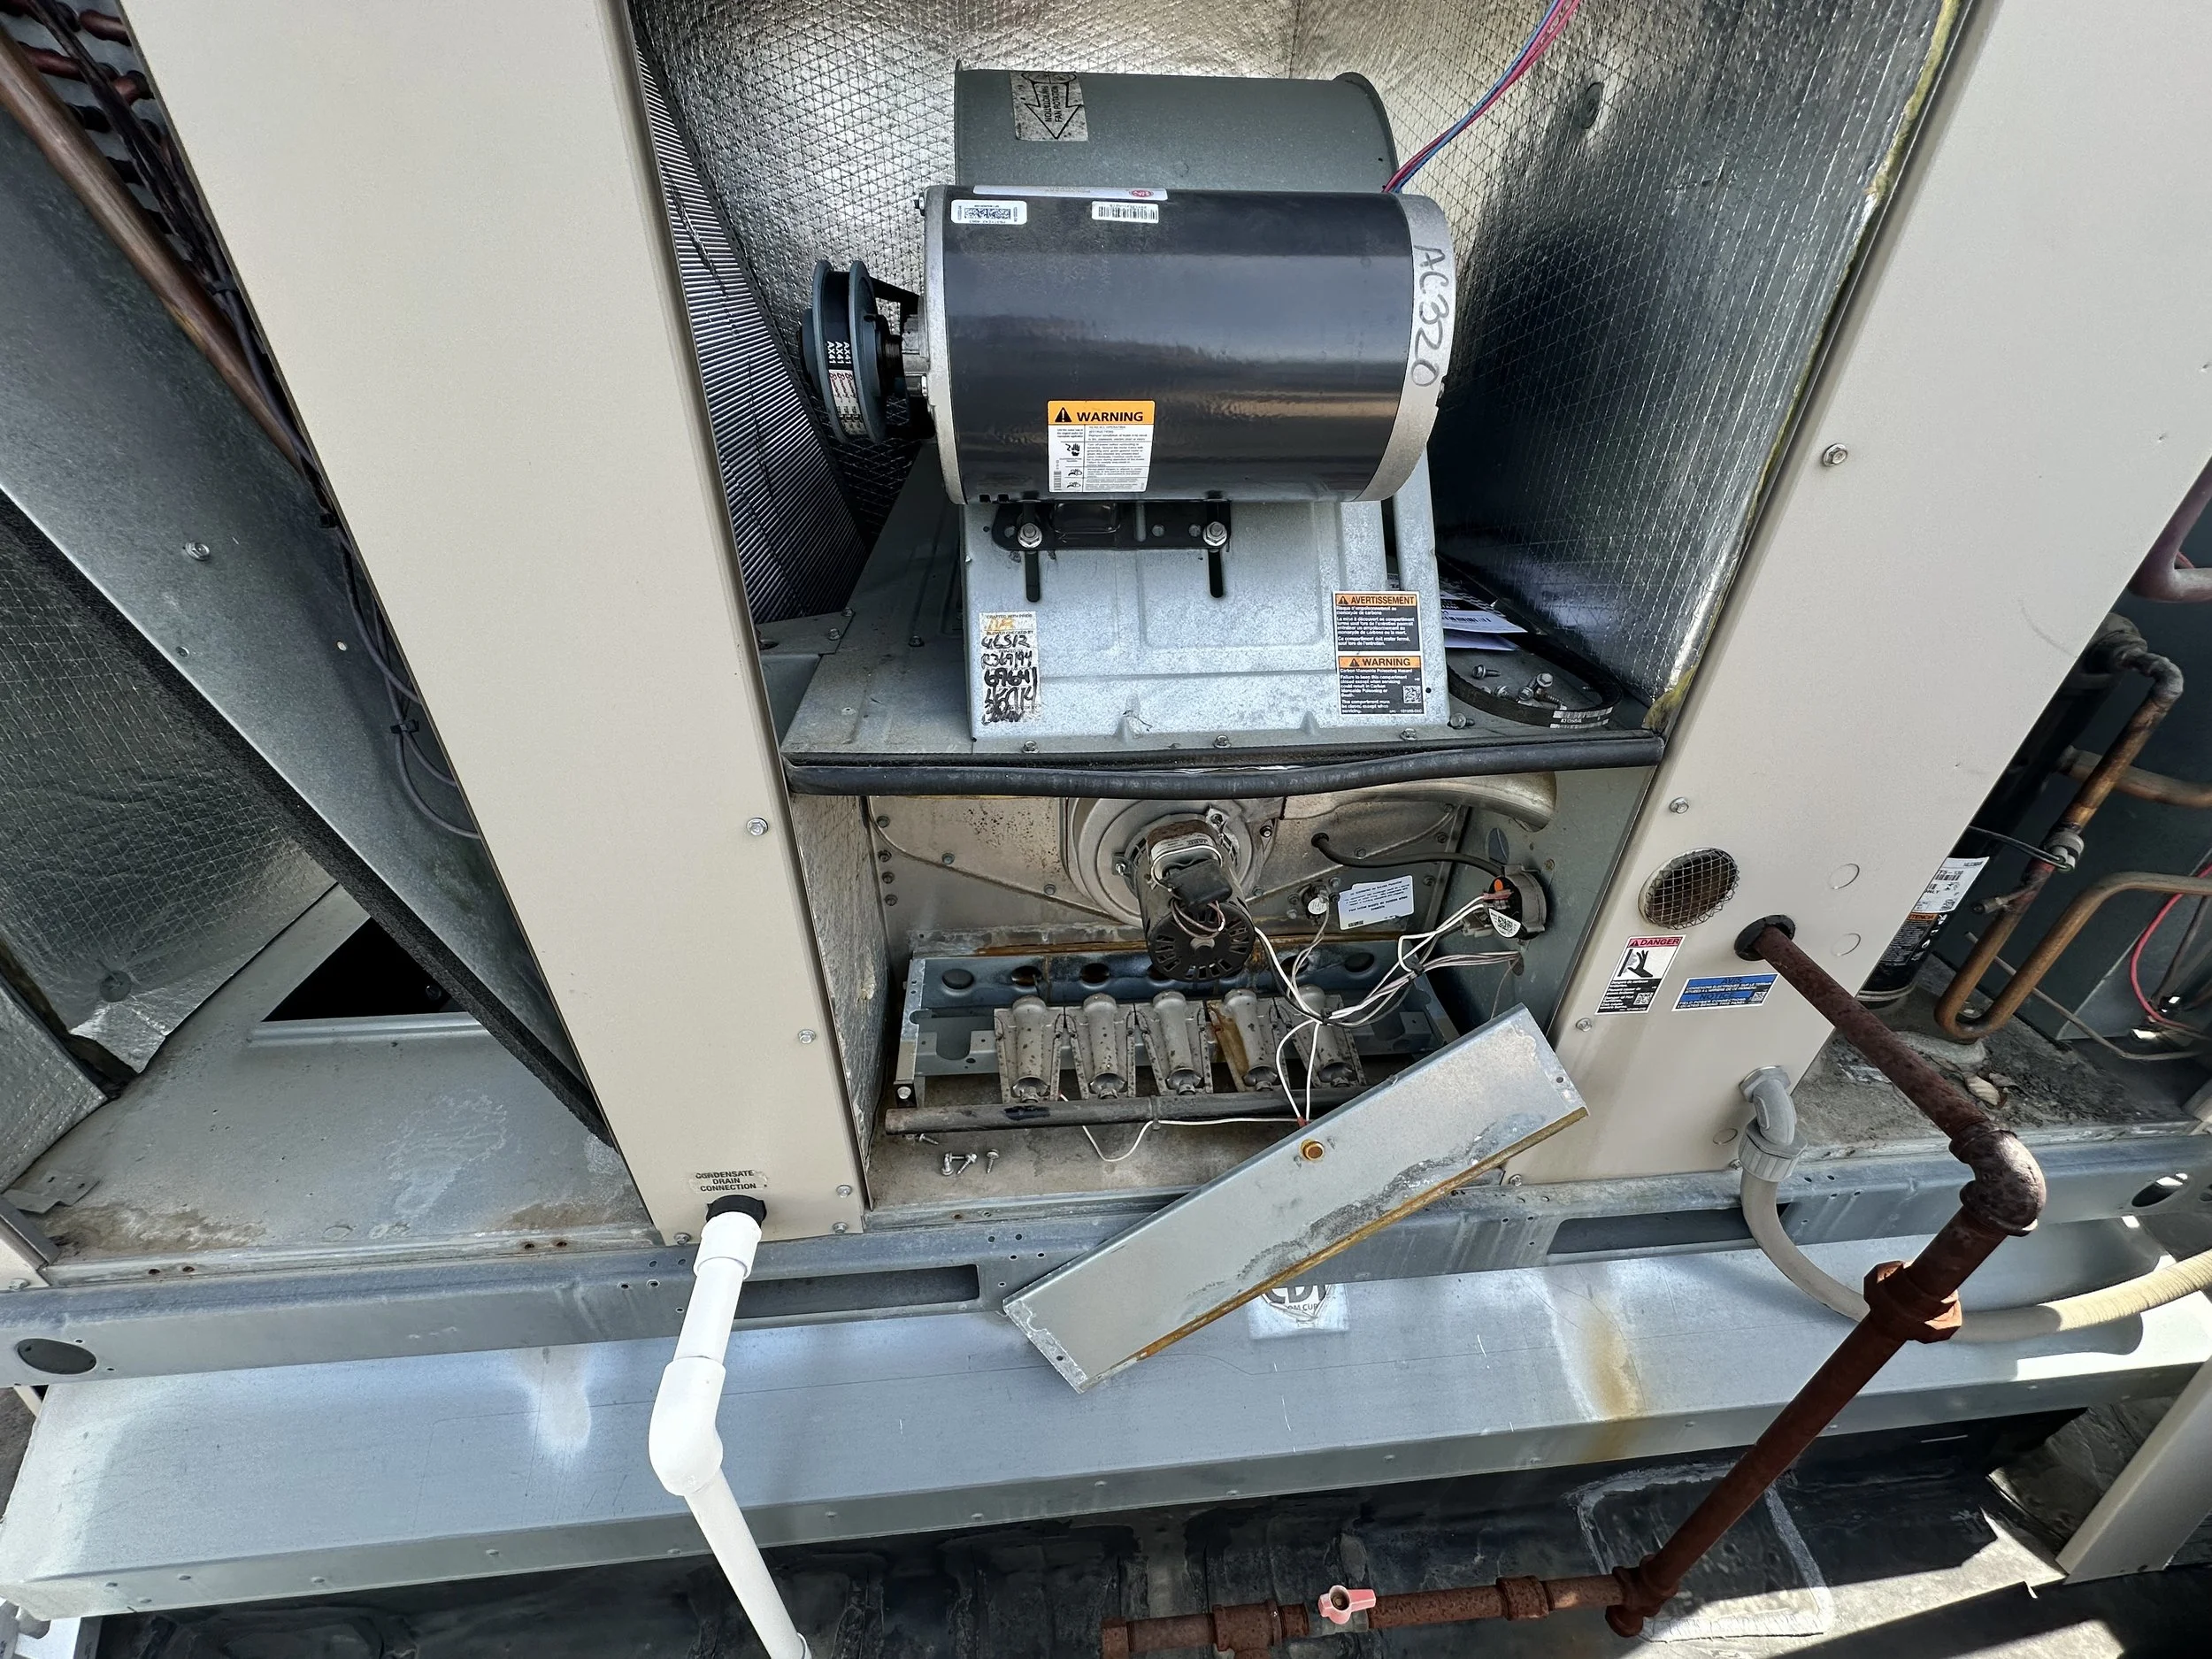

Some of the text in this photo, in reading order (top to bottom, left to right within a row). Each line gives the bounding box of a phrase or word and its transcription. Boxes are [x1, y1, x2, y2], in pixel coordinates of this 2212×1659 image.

[1054, 111, 1063, 123] FAN
[1411, 245, 1449, 388] AC320
[827, 342, 836, 364] AX41
[835, 342, 844, 364] AX41
[842, 342, 851, 364] AX41
[1077, 411, 1143, 422] WARNING
[1351, 595, 1414, 605] AVERTISSEMENT
[1363, 657, 1411, 666] WARNING
[695, 1170, 755, 1179] CONDENSATE
